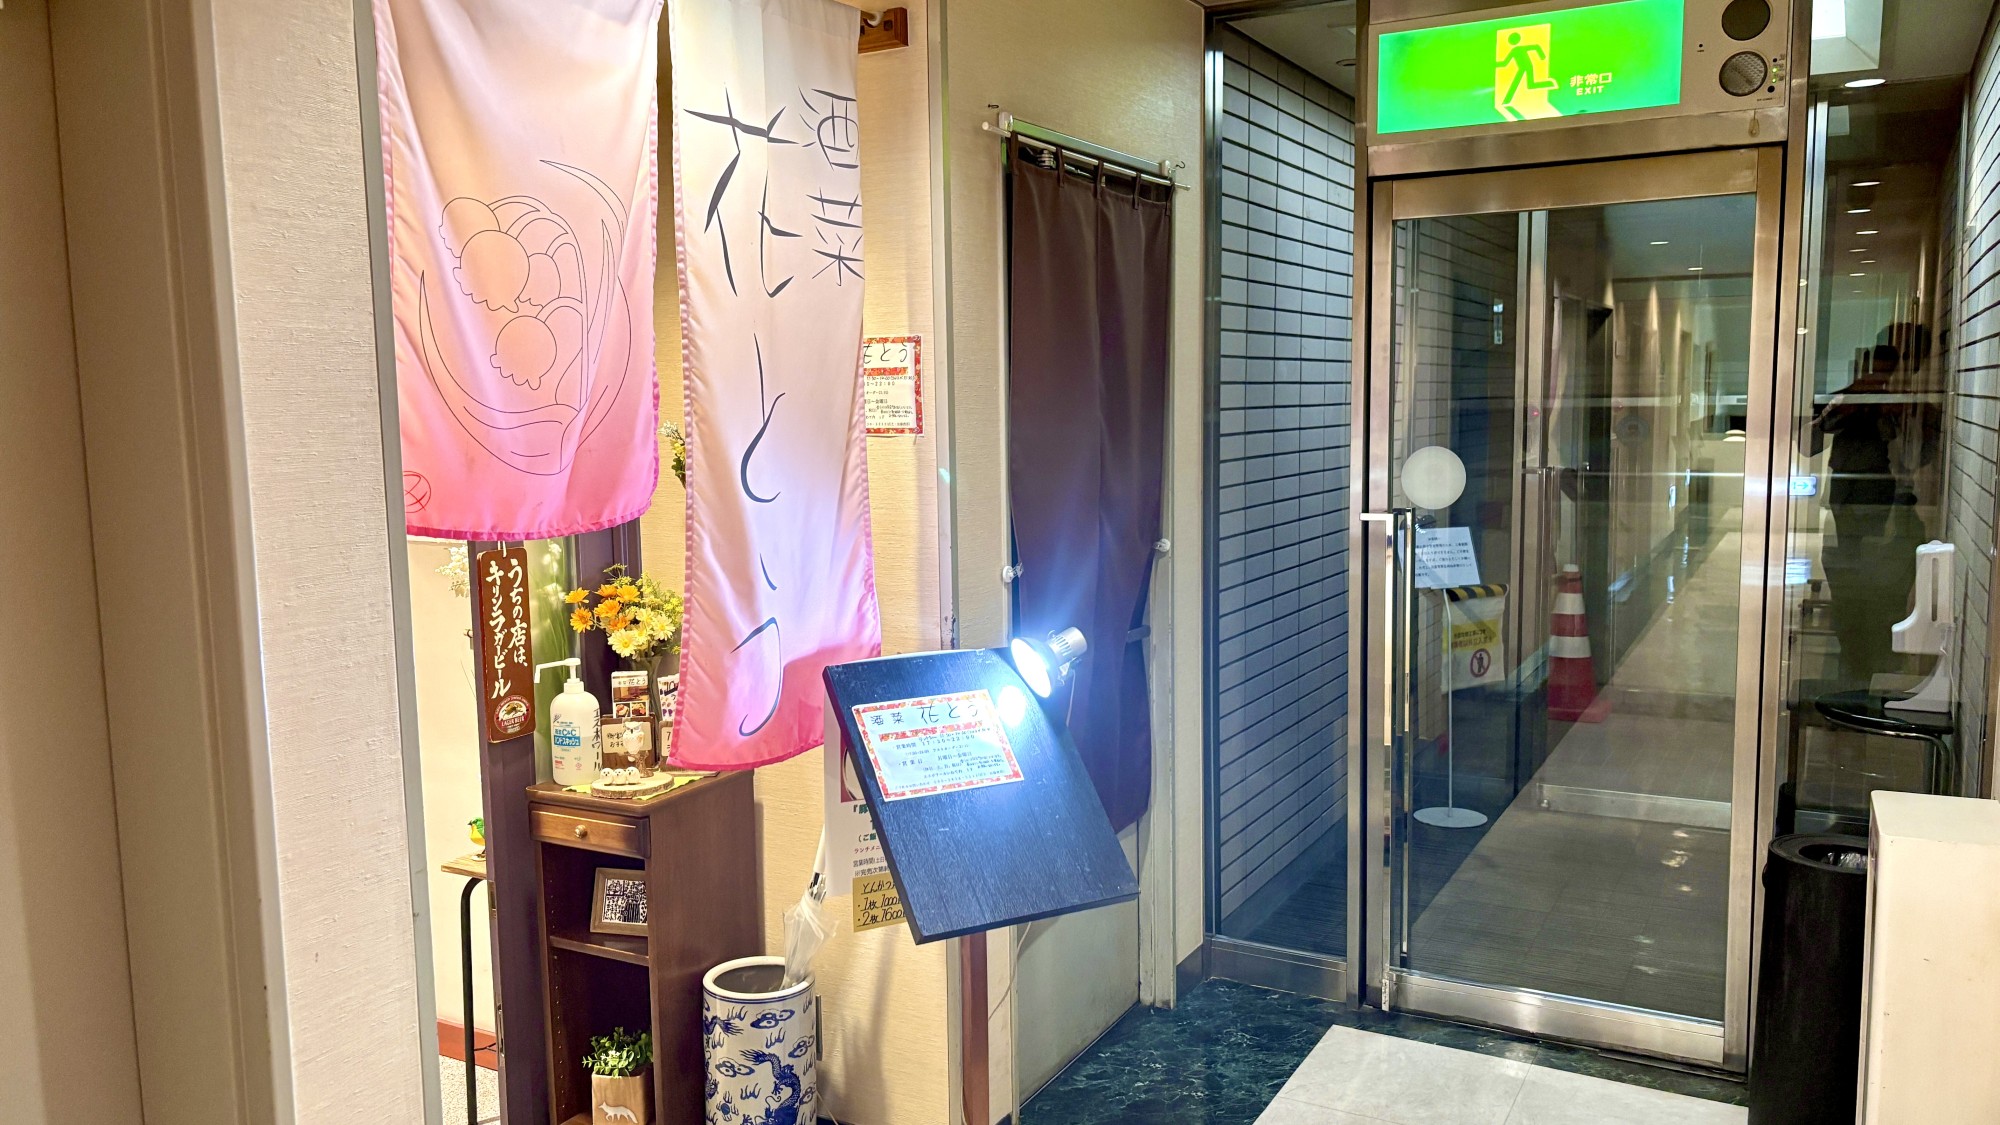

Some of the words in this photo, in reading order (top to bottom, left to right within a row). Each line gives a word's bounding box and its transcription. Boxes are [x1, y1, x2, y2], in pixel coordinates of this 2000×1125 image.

[1570, 72, 1612, 87] 非常口
[1576, 85, 1604, 96] EXIT
[486, 560, 512, 699] キリンラガービール
[508, 558, 528, 667] うちの店は、
